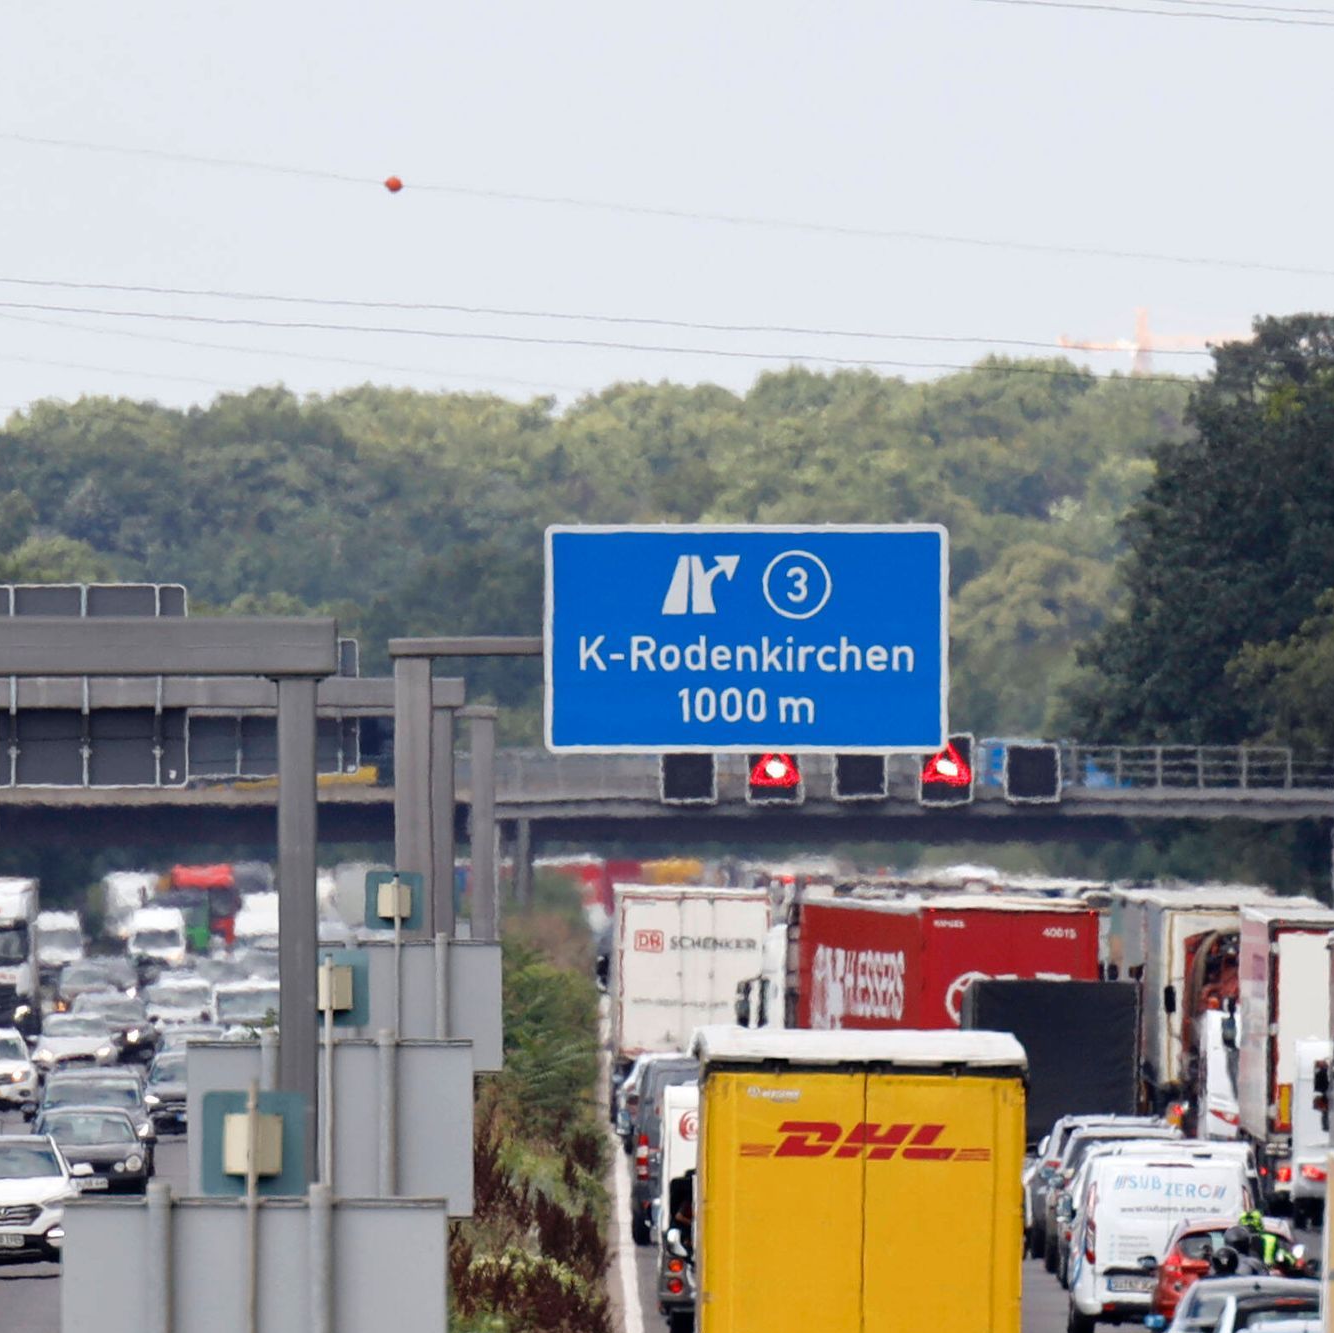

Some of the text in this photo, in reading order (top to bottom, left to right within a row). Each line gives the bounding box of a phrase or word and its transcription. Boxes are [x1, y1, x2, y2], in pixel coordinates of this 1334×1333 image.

[786, 566, 809, 602] 3
[578, 634, 915, 673] K-Rodenkirchen
[678, 687, 815, 724] 1000 m
[669, 936, 757, 950] SCHENKER
[774, 1121, 956, 1161] DHL
